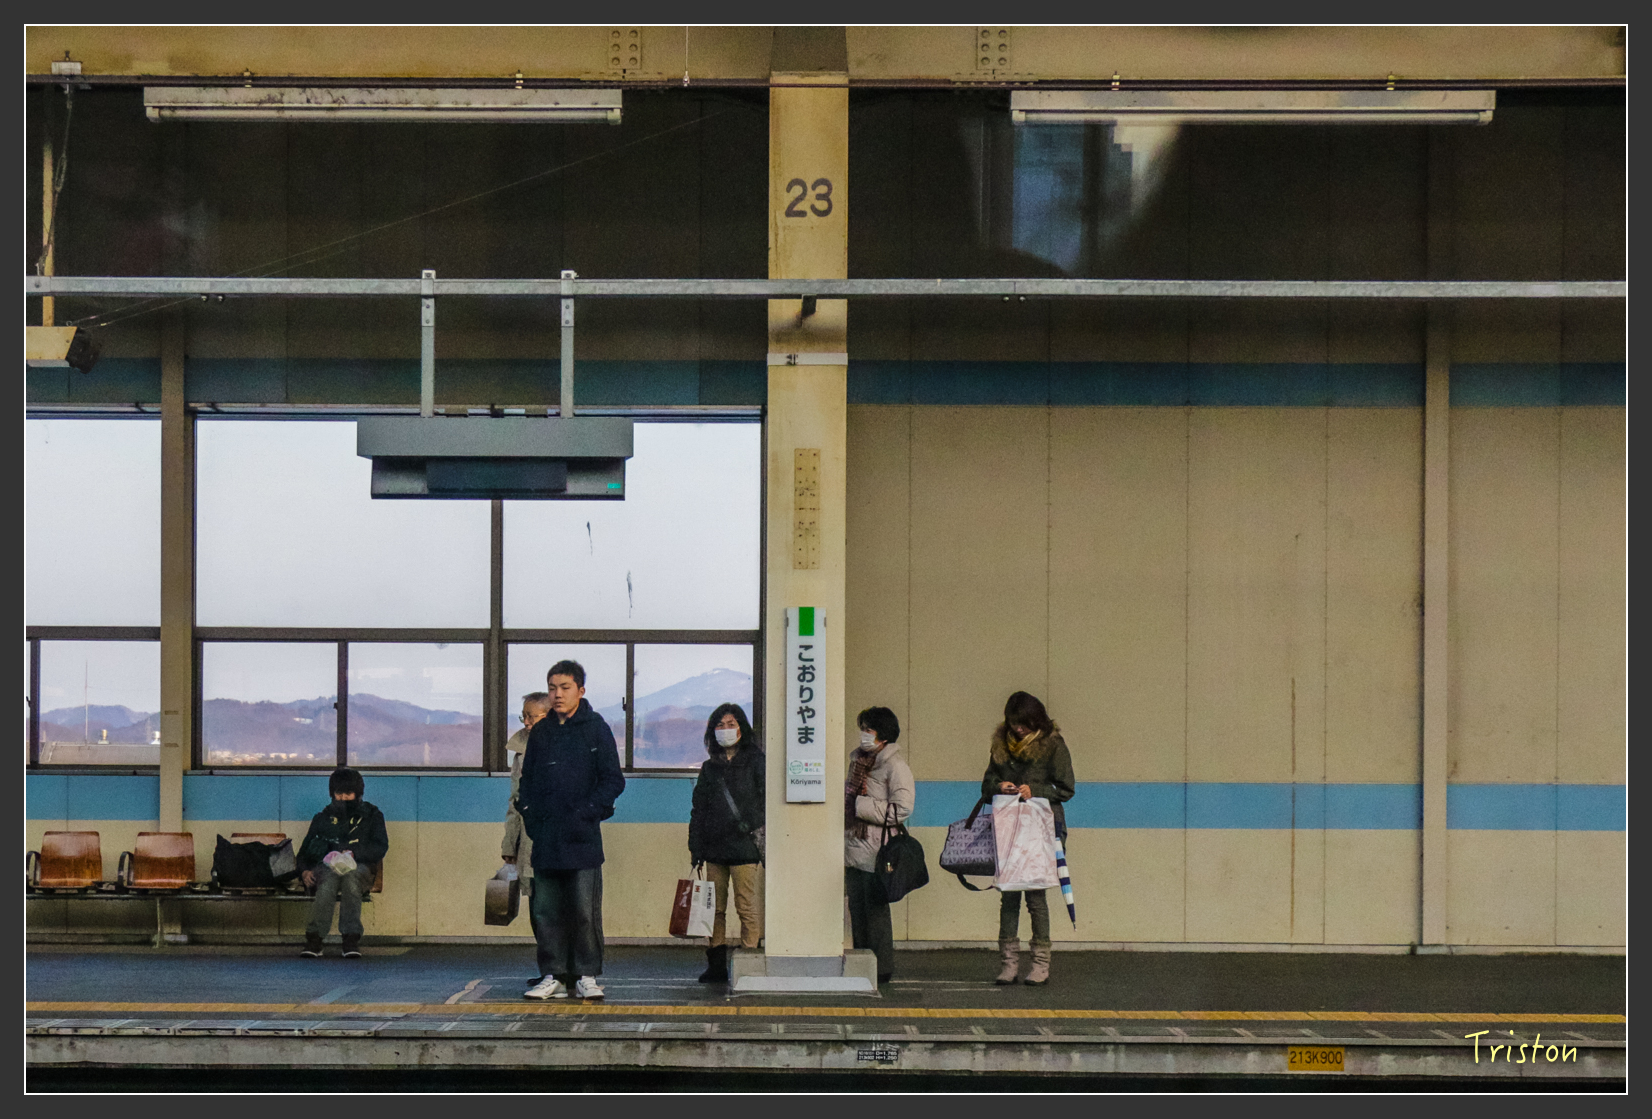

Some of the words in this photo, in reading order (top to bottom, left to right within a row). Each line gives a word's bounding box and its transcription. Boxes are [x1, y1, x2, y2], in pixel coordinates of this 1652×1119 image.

[785, 178, 833, 218] 23
[797, 644, 816, 745] こおりやま
[1290, 1050, 1343, 1065] 213K900
